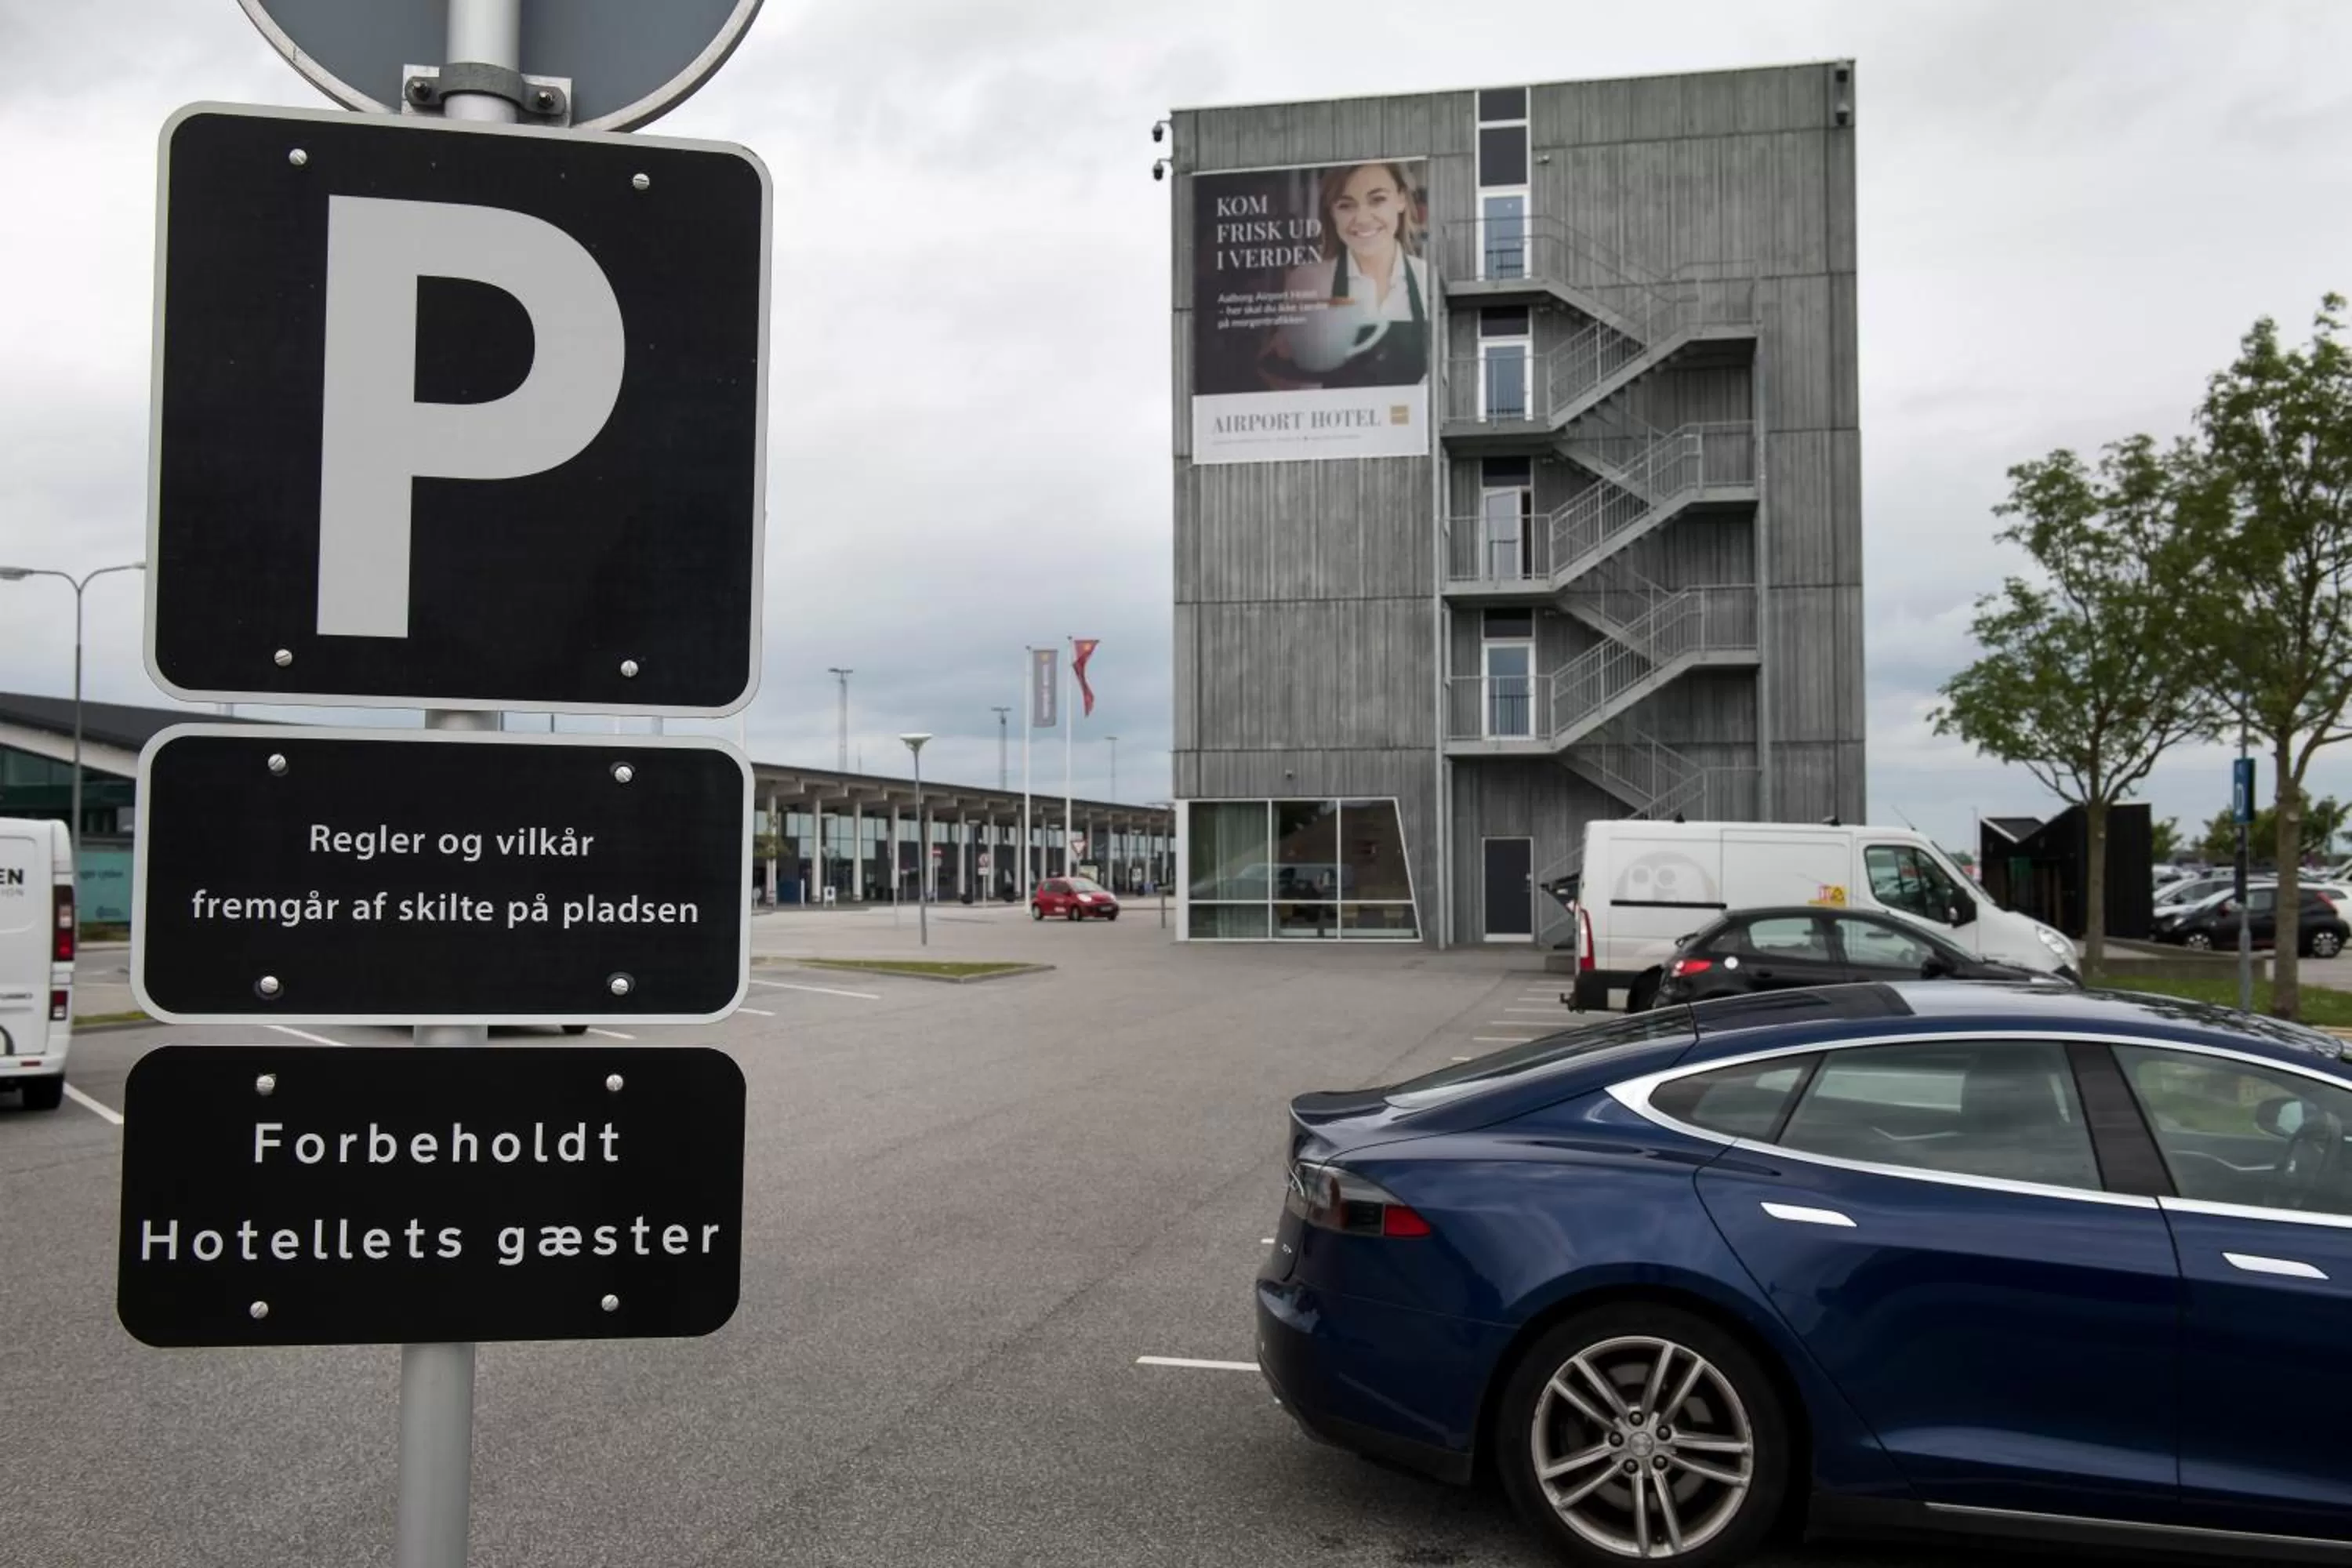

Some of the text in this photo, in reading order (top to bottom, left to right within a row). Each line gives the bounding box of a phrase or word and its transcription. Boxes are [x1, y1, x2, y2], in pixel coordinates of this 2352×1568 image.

[1217, 194, 1268, 217] KOM
[1217, 219, 1322, 244] FRISK UD
[1217, 244, 1323, 270] I VERDEN
[317, 194, 626, 638] P
[1213, 408, 1381, 434] AIRPORT HOTEL
[310, 825, 594, 862] Regler og vilkår
[191, 889, 698, 929] fremgår af skilte på pladsen
[254, 1122, 619, 1164] Forbeholdt
[142, 1215, 719, 1266] Hotellets gæster
